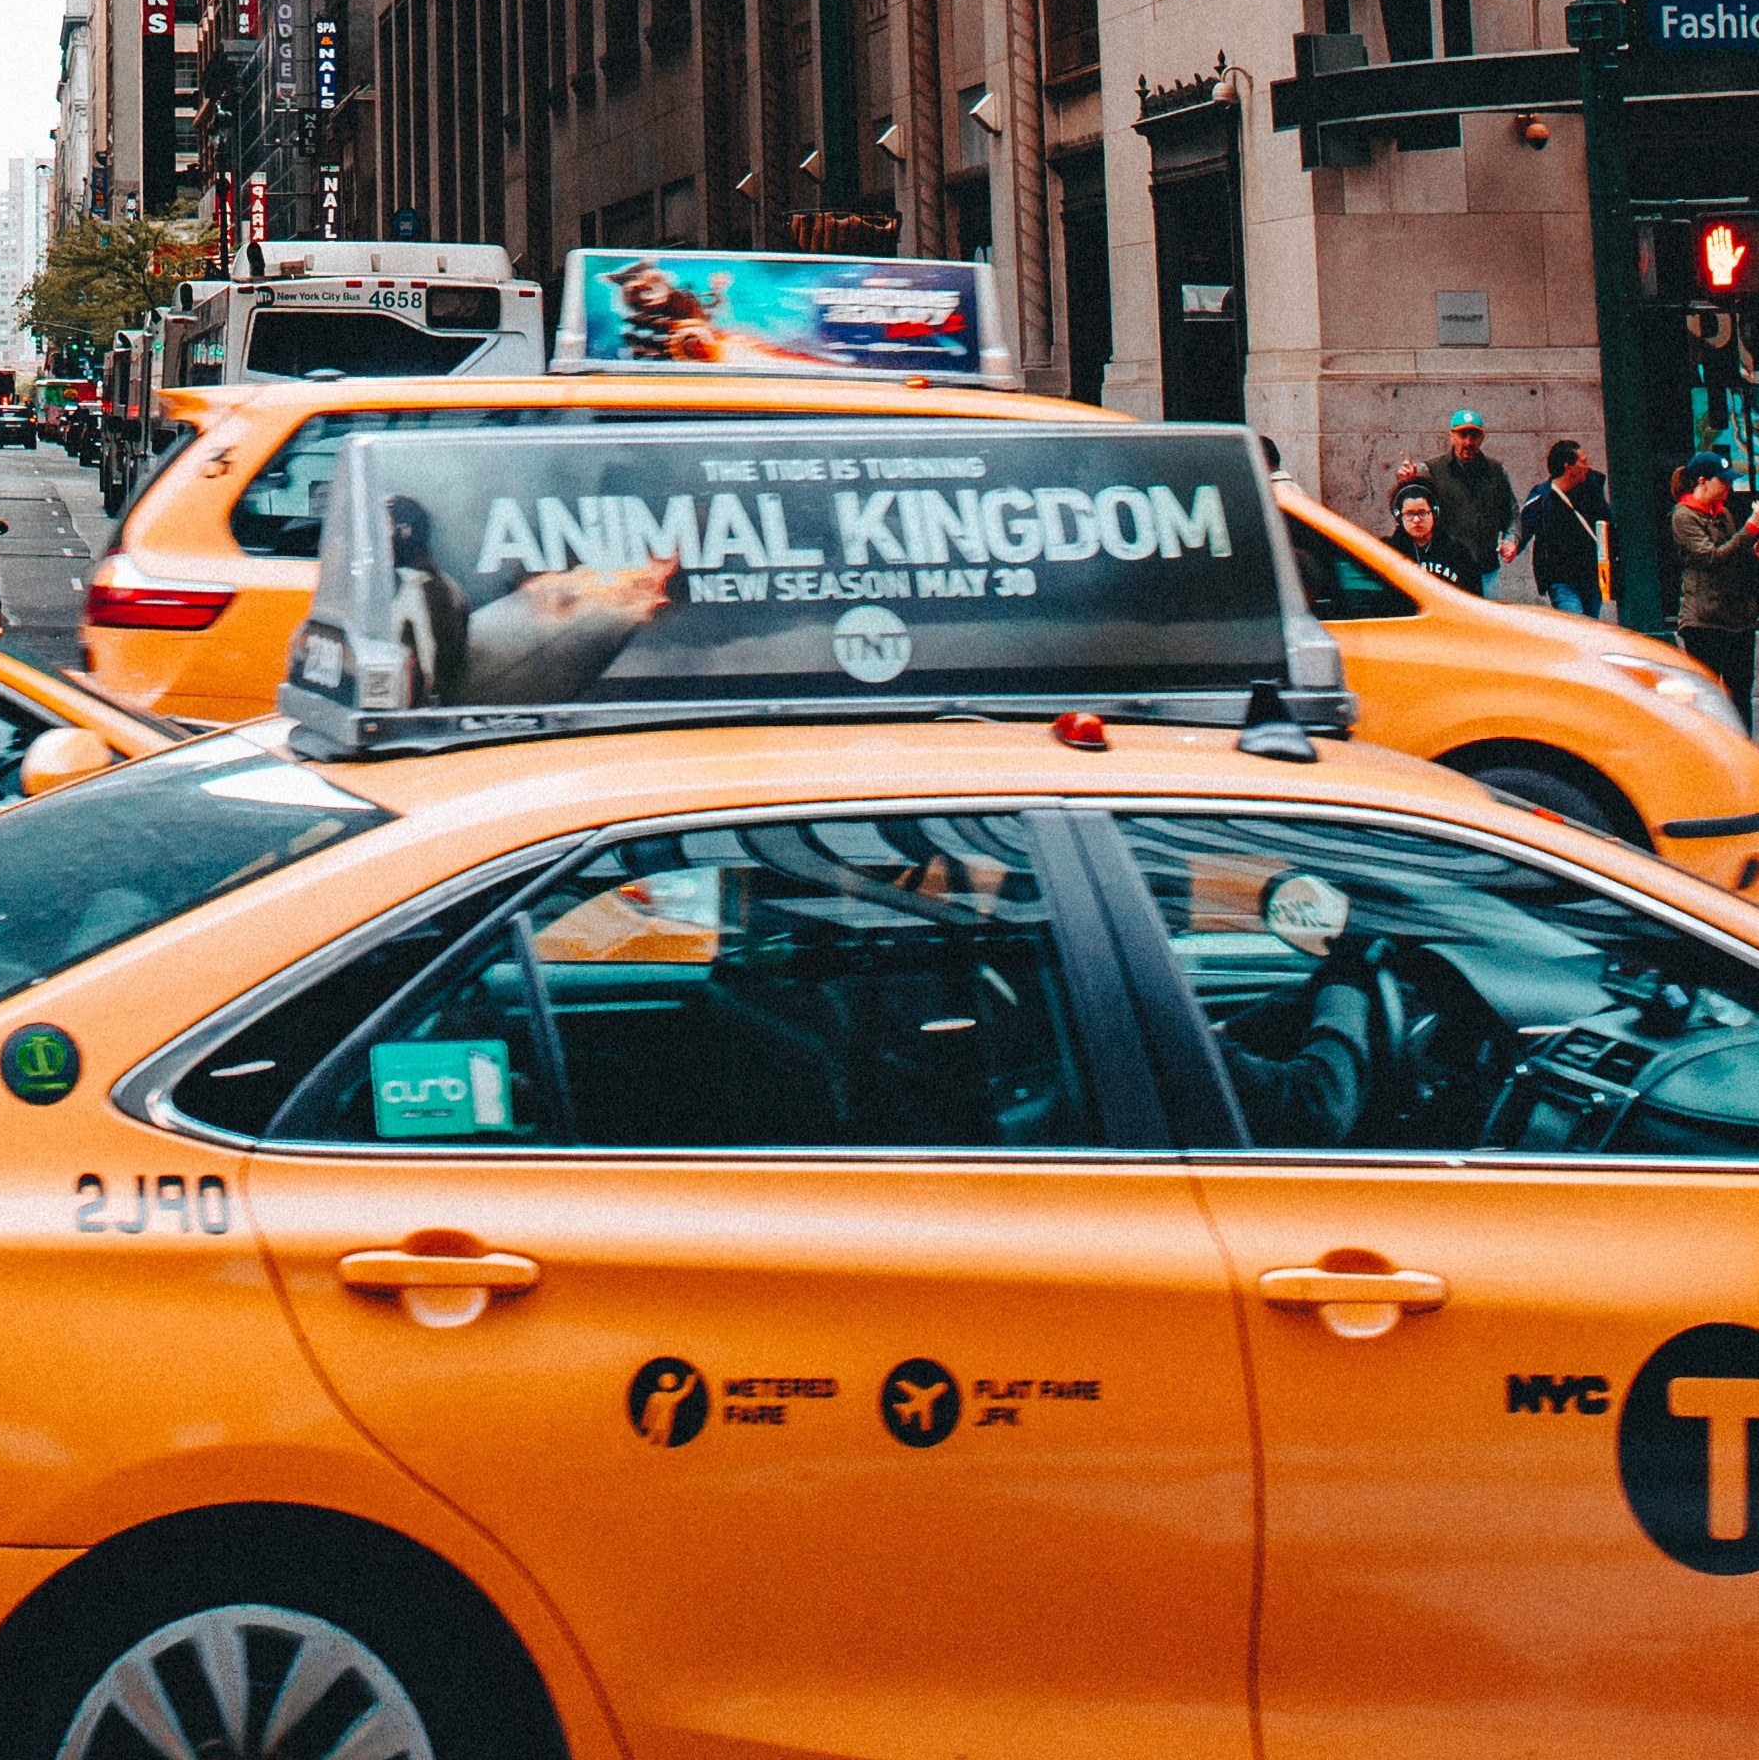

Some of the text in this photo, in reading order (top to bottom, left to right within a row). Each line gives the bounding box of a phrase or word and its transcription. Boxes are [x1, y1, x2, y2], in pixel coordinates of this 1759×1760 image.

[316, 21, 336, 34] SPA
[318, 48, 336, 109] NAILS
[322, 177, 339, 239] NAIL
[276, 292, 297, 301] New
[298, 292, 320, 301] York
[321, 292, 340, 303] City
[342, 292, 361, 301] Bus
[368, 291, 423, 309] 4658
[700, 457, 986, 481] THE TIDE IS TURNING
[477, 485, 1232, 573] ANIMAL KINGDOM
[689, 568, 1037, 603] NEW SEASON MAY 30
[1506, 1374, 1611, 1415] NYC
